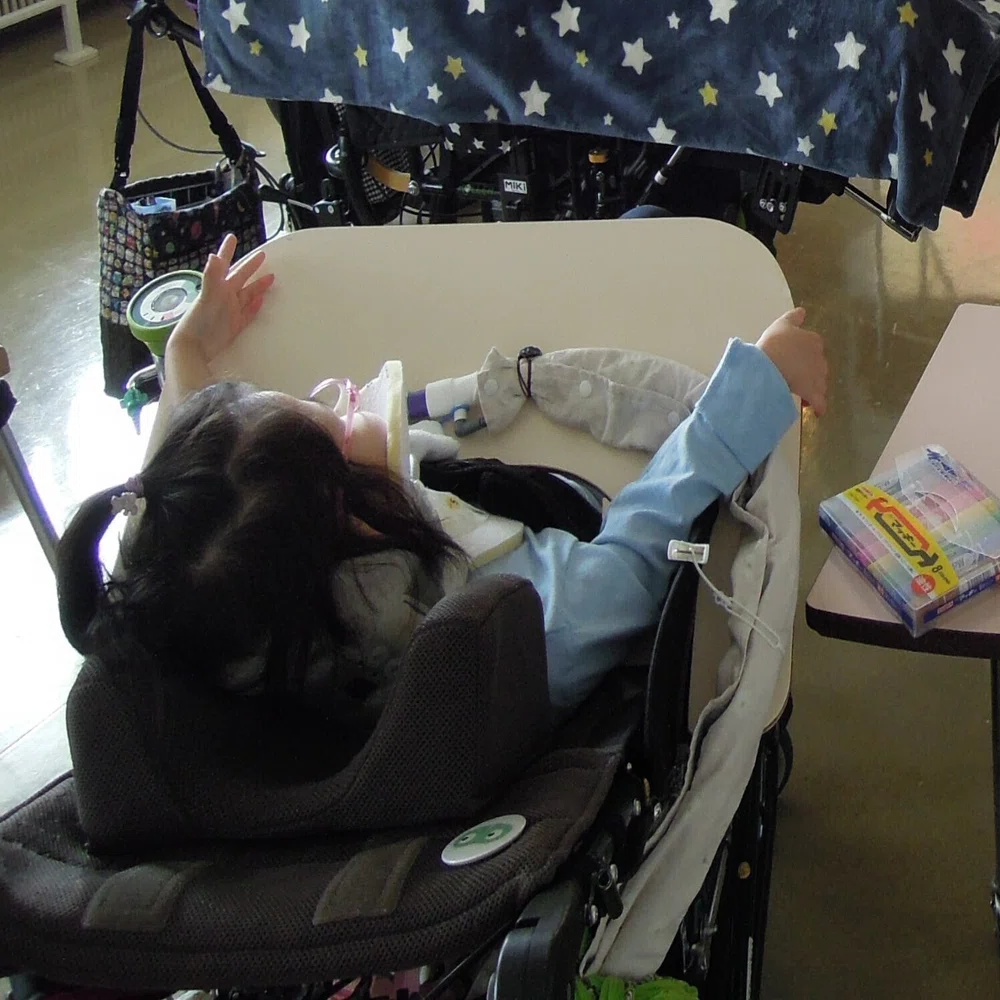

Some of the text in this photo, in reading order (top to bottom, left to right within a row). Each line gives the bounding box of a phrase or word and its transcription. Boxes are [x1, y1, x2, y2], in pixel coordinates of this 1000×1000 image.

[891, 519, 917, 549] マッキー
[931, 564, 943, 574] 8
